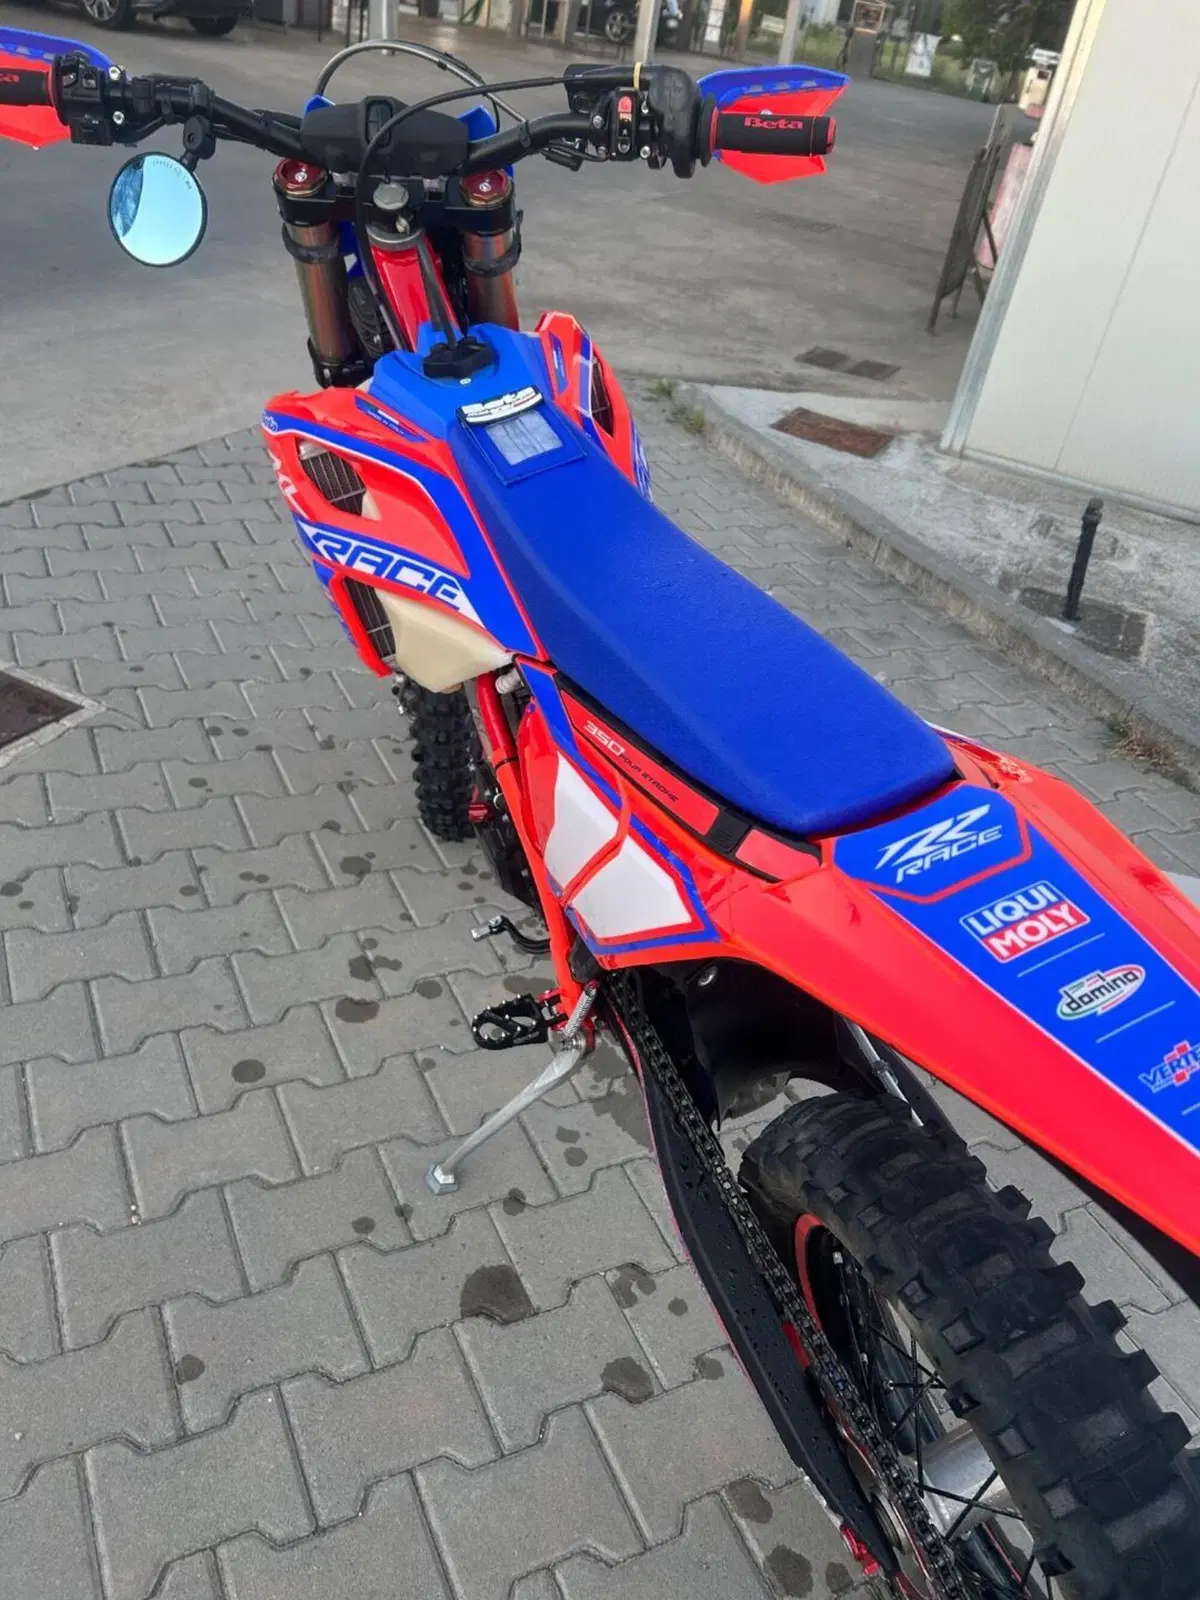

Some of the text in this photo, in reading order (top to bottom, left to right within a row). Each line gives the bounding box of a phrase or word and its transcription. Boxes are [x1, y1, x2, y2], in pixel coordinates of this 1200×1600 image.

[744, 115, 803, 129] Beta
[311, 531, 461, 612] RACE
[583, 719, 625, 757] 350
[895, 824, 1003, 884] RACE
[966, 884, 1060, 937] LIQUI
[987, 902, 1078, 958] MOLY
[1063, 971, 1140, 1012] domino
